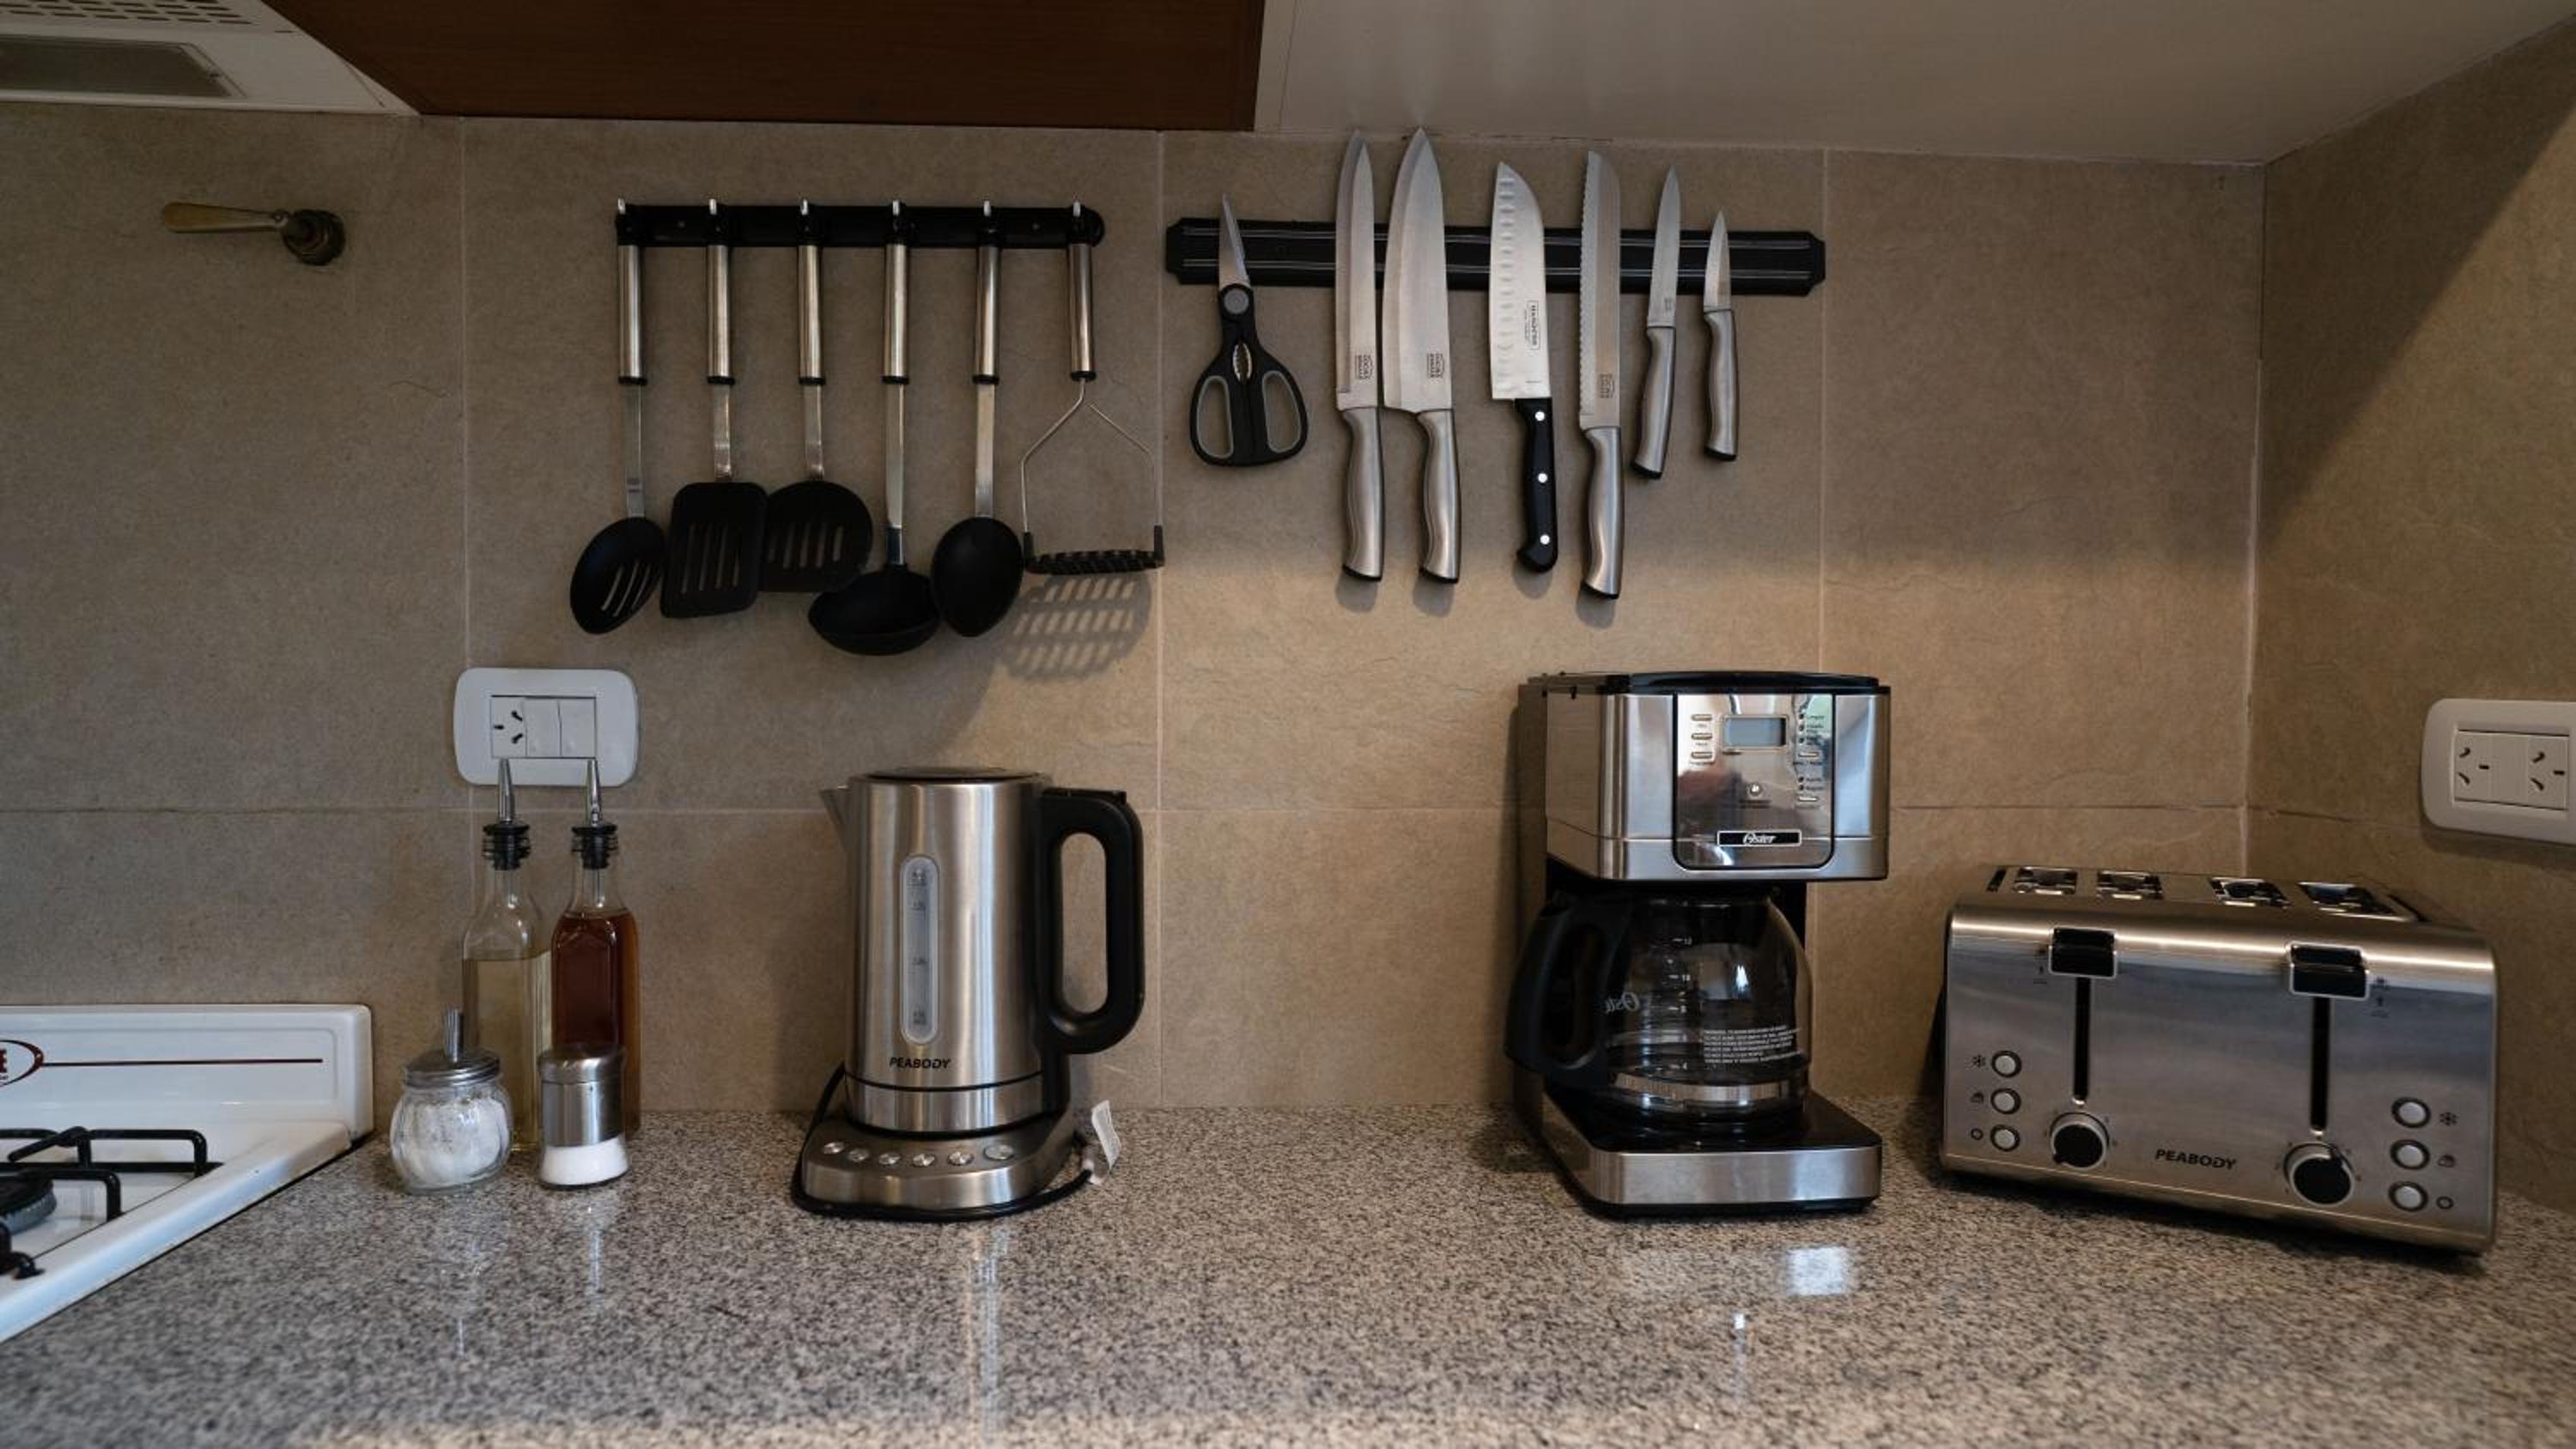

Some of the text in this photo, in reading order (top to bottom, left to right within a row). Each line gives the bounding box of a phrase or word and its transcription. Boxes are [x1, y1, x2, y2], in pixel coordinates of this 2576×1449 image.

[1742, 832, 1777, 846] Oster
[889, 1057, 951, 1069] PEABODY
[2154, 1149, 2237, 1170] PEABODY
